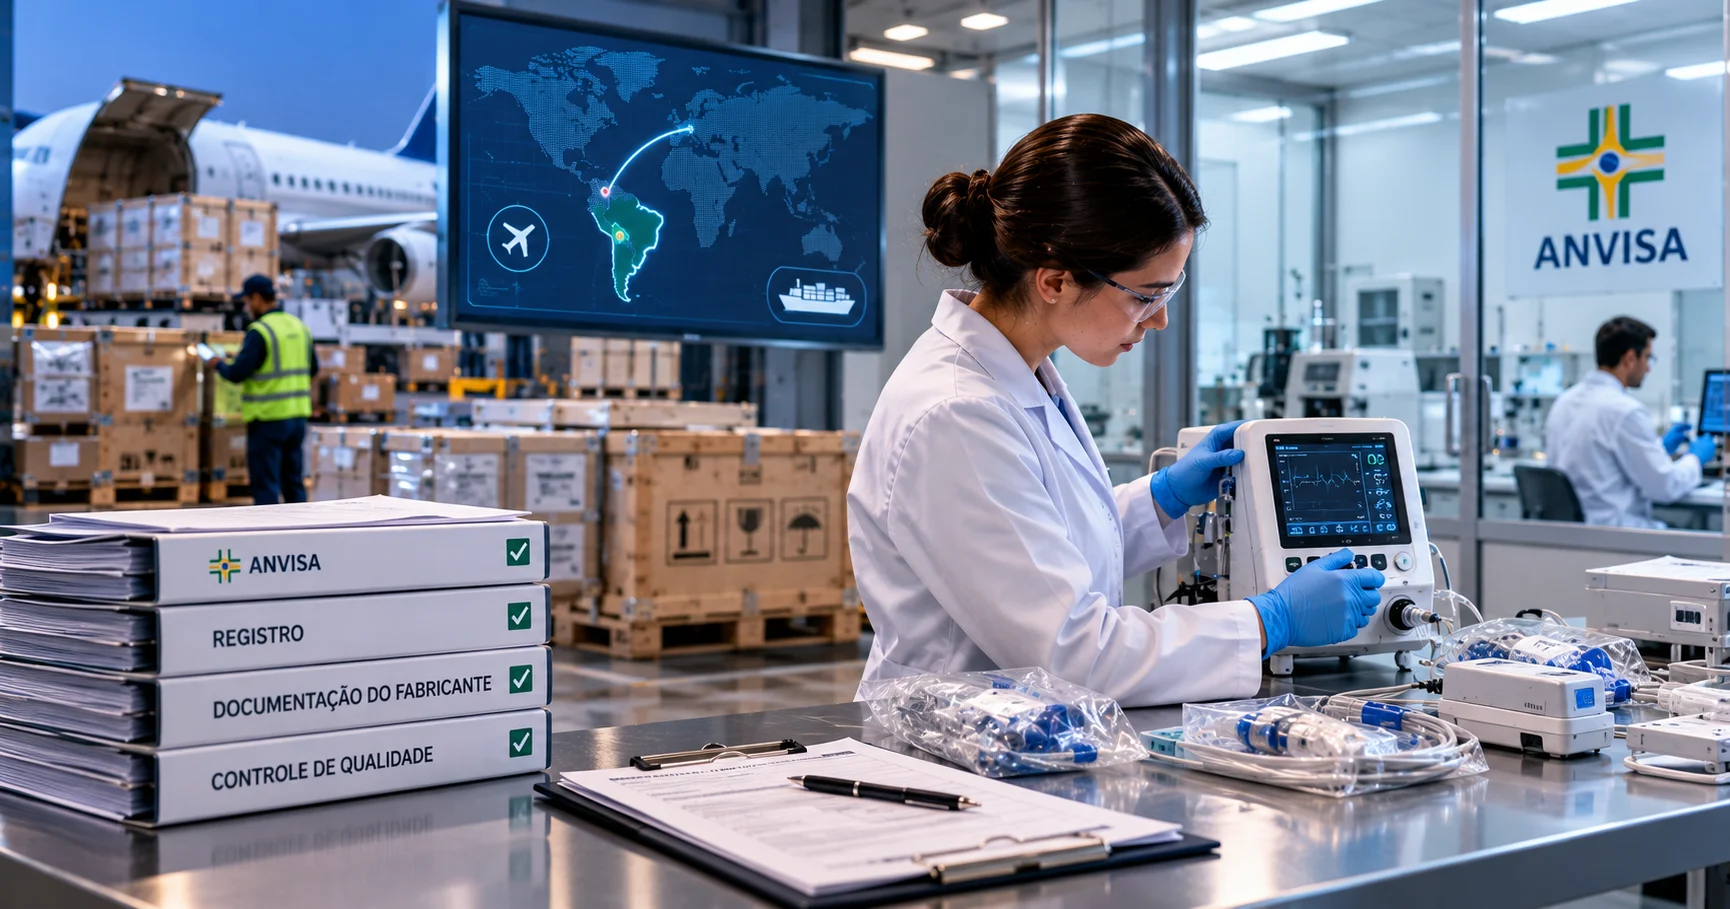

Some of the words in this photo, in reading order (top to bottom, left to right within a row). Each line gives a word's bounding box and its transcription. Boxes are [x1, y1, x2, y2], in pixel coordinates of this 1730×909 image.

[1534, 227, 1688, 270] ANVISA
[248, 553, 321, 574] ANVISA
[212, 624, 304, 648] REGISTRO
[212, 684, 363, 719] DOCUMENTAÇÃO
[367, 684, 392, 703] DO
[395, 674, 492, 700] FABRICANTE
[211, 762, 309, 791] CONTROLE
[313, 758, 336, 777] DE
[340, 745, 434, 775] QUALIDADE
